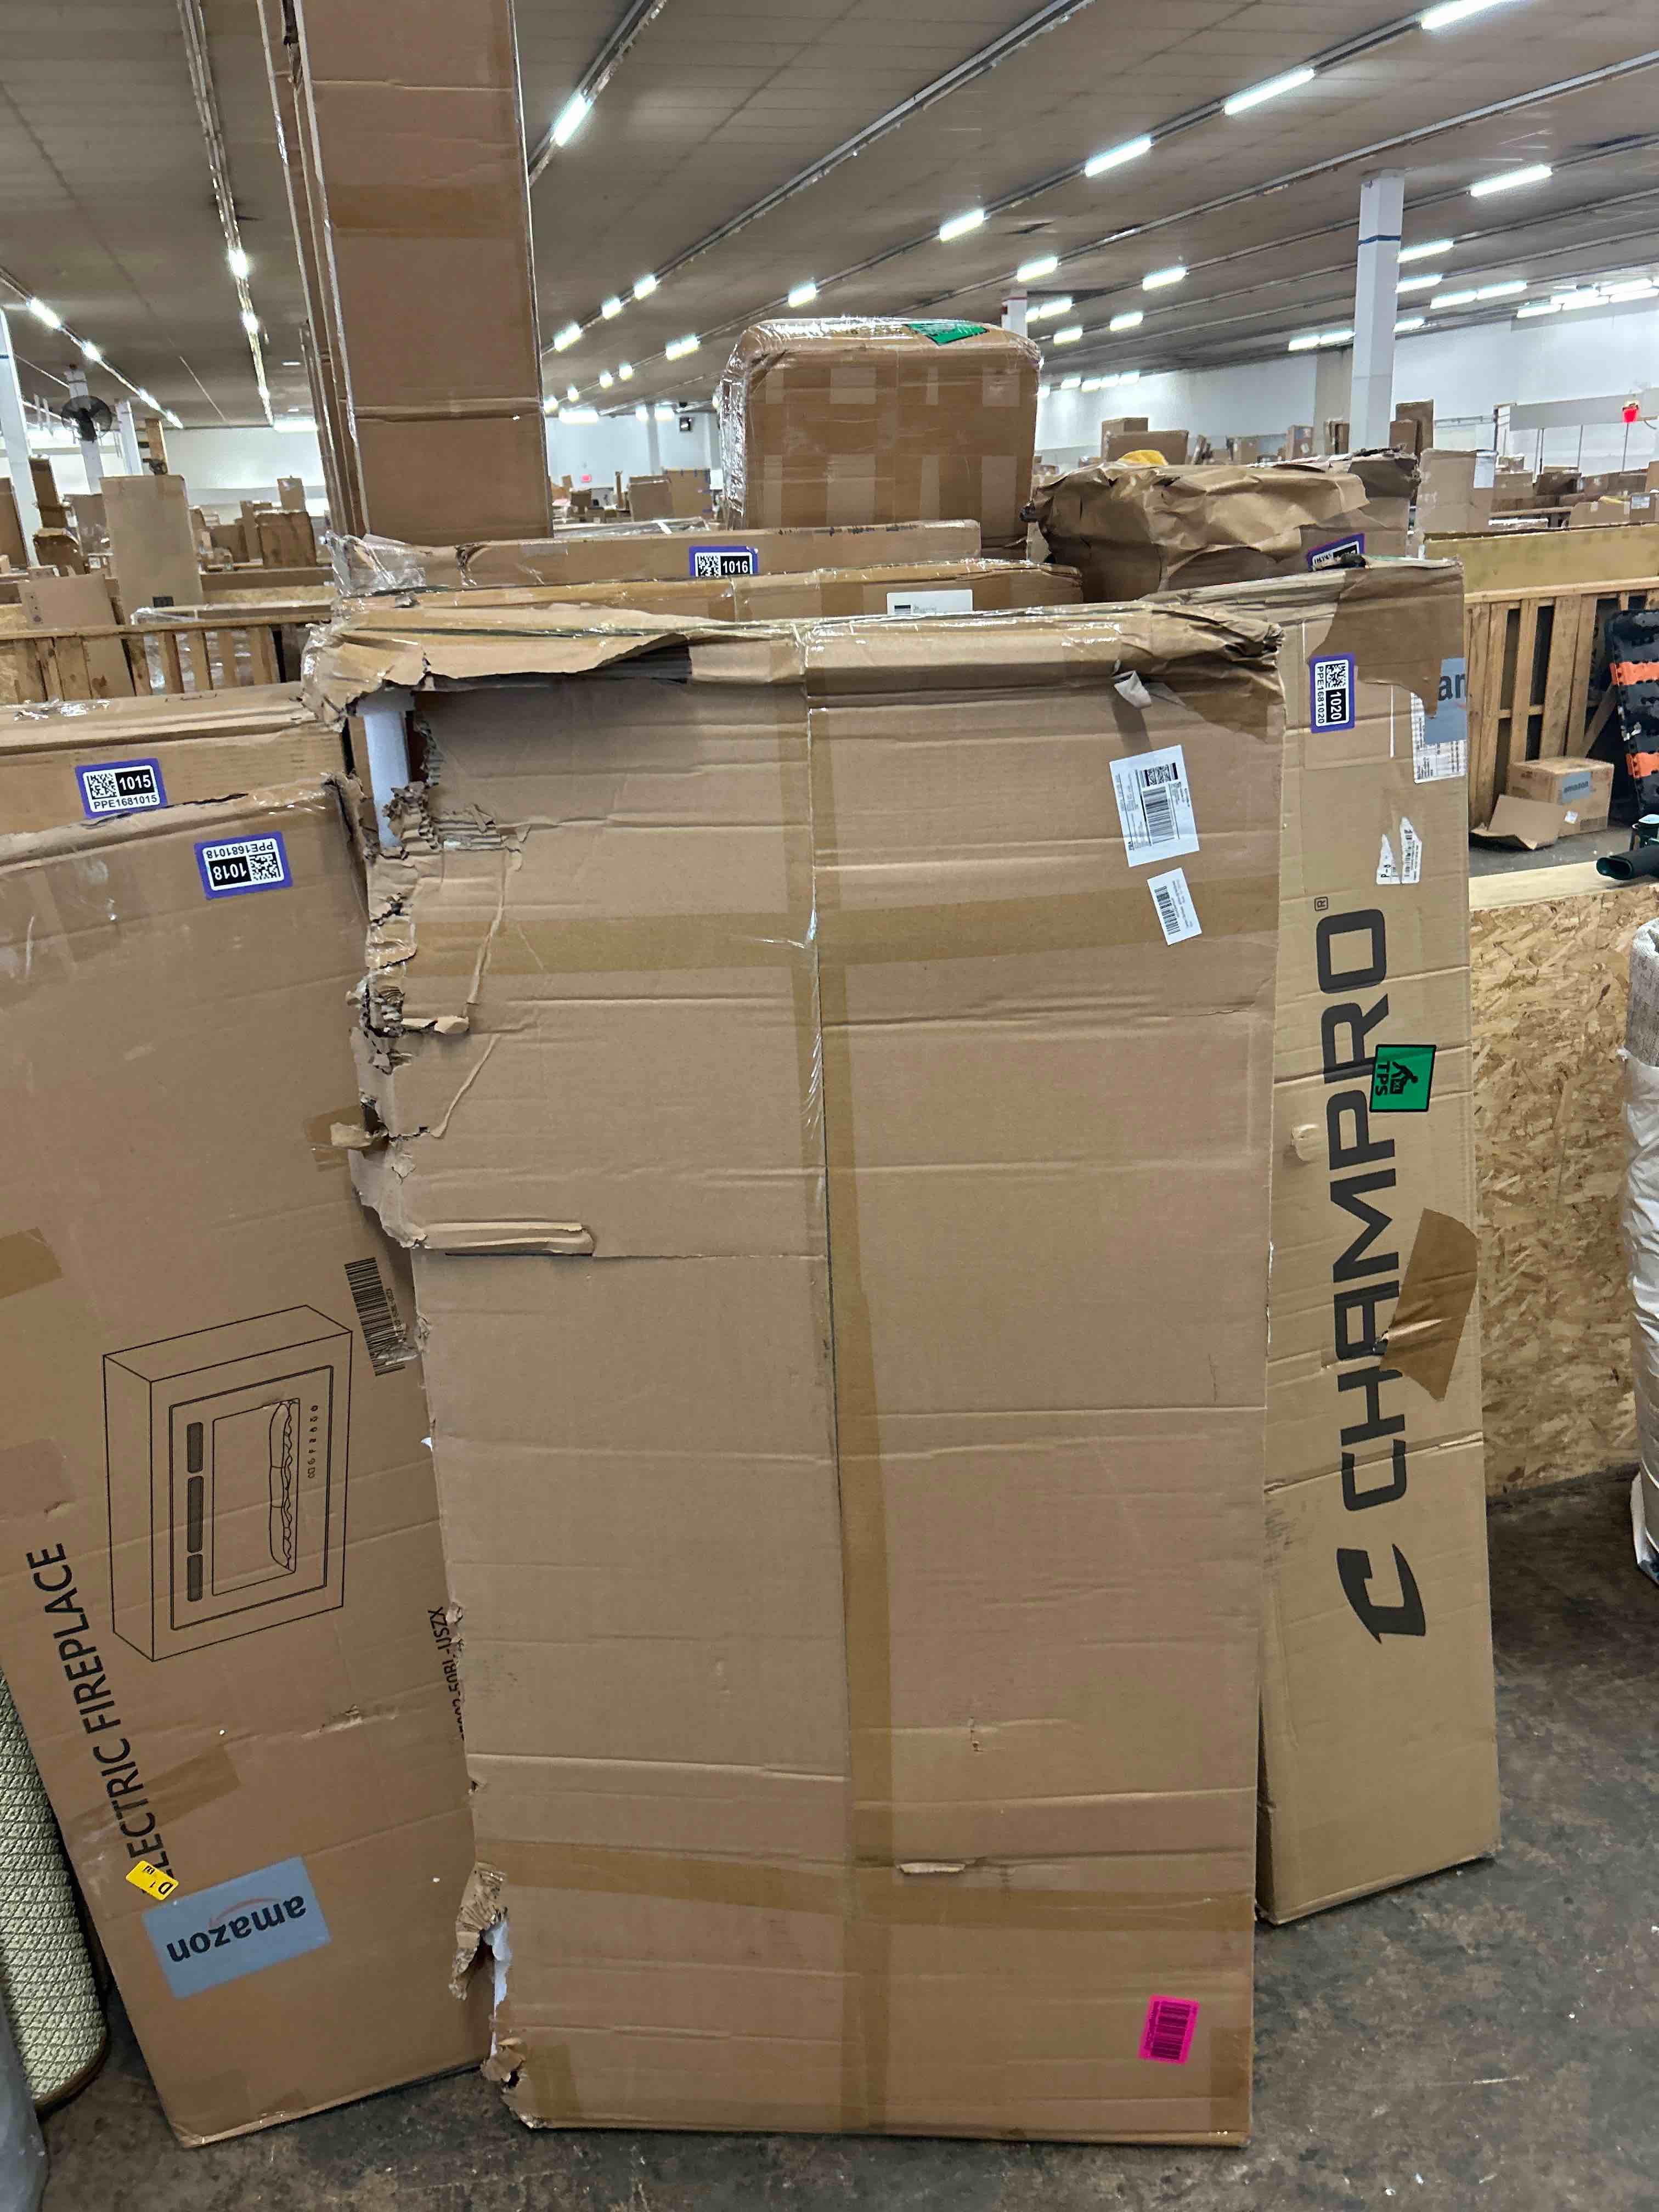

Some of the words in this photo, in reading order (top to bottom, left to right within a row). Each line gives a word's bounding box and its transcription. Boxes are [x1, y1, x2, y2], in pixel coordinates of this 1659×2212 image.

[723, 560, 748, 574] 1016
[1317, 665, 1325, 724] PPE1681020
[1330, 691, 1342, 720] 1020
[119, 775, 152, 791] 1015
[94, 794, 158, 809] PPE1681015
[206, 841, 274, 860] PPE1681018
[213, 863, 247, 881] 1018
[1375, 1060, 1391, 1096] TPS
[1316, 909, 1407, 1511] CHAMPRO
[26, 1543, 121, 1734] FIREPLACE
[93, 1737, 175, 1893] LECTRIC
[166, 1895, 306, 1962] amazon
